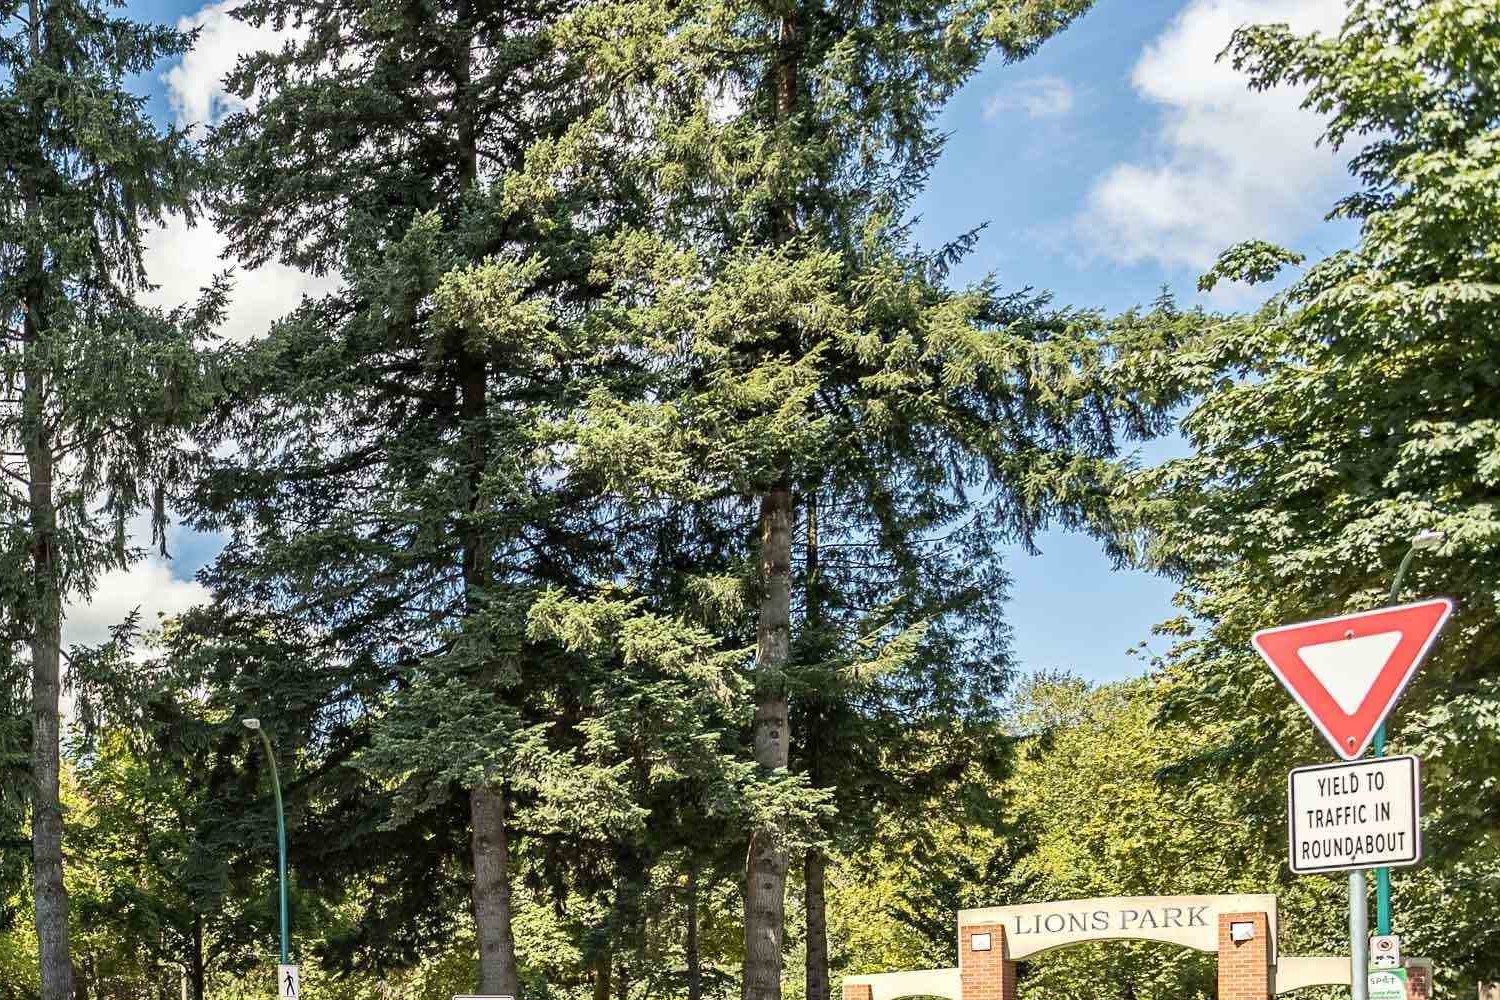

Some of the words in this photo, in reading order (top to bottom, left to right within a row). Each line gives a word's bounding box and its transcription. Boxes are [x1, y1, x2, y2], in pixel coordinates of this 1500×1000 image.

[1318, 773, 1359, 797] YIELD
[1366, 771, 1385, 792] TO
[1307, 804, 1367, 829] TRAFFIC
[1375, 801, 1391, 822] IN
[1302, 831, 1405, 860] ROUNDABOUT
[1013, 910, 1110, 935] LIONS
[1119, 906, 1211, 930] PARK
